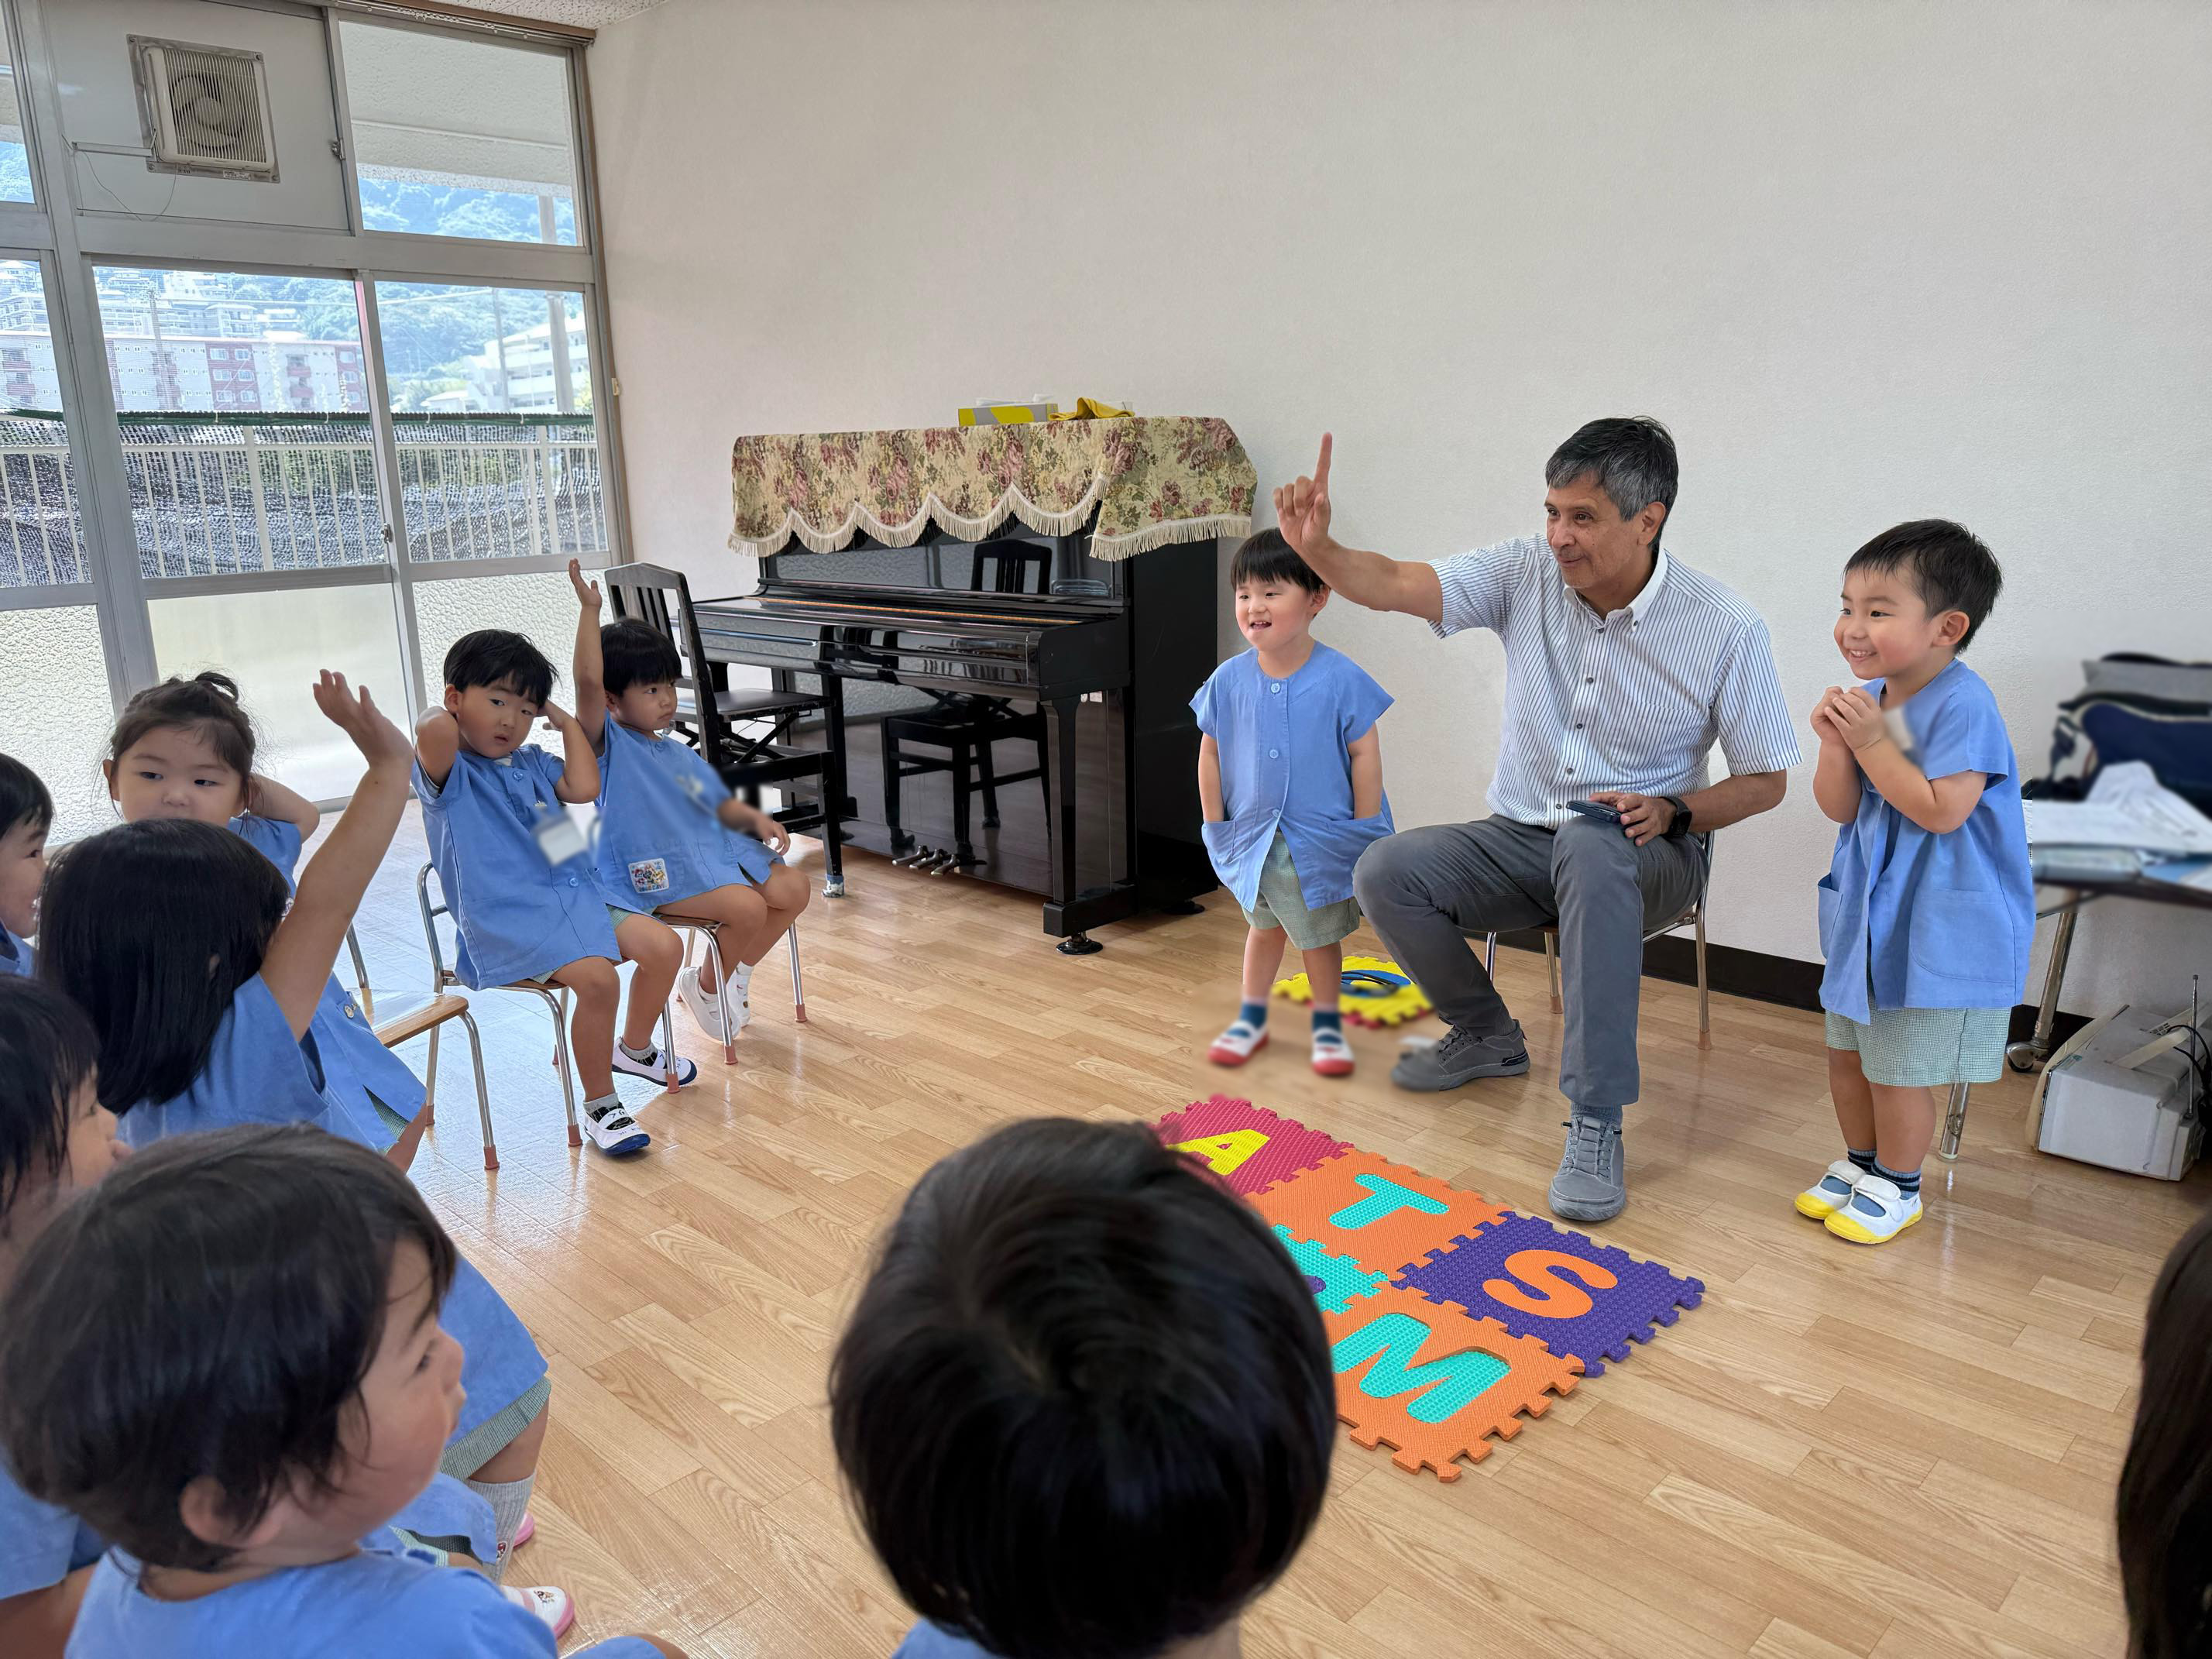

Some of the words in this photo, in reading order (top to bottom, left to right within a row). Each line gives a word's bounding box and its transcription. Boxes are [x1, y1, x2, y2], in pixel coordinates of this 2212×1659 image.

[1164, 1129, 1270, 1176] A
[1329, 1173, 1448, 1229] T
[1483, 1249, 1618, 1319] S
[1329, 1313, 1511, 1424] M
